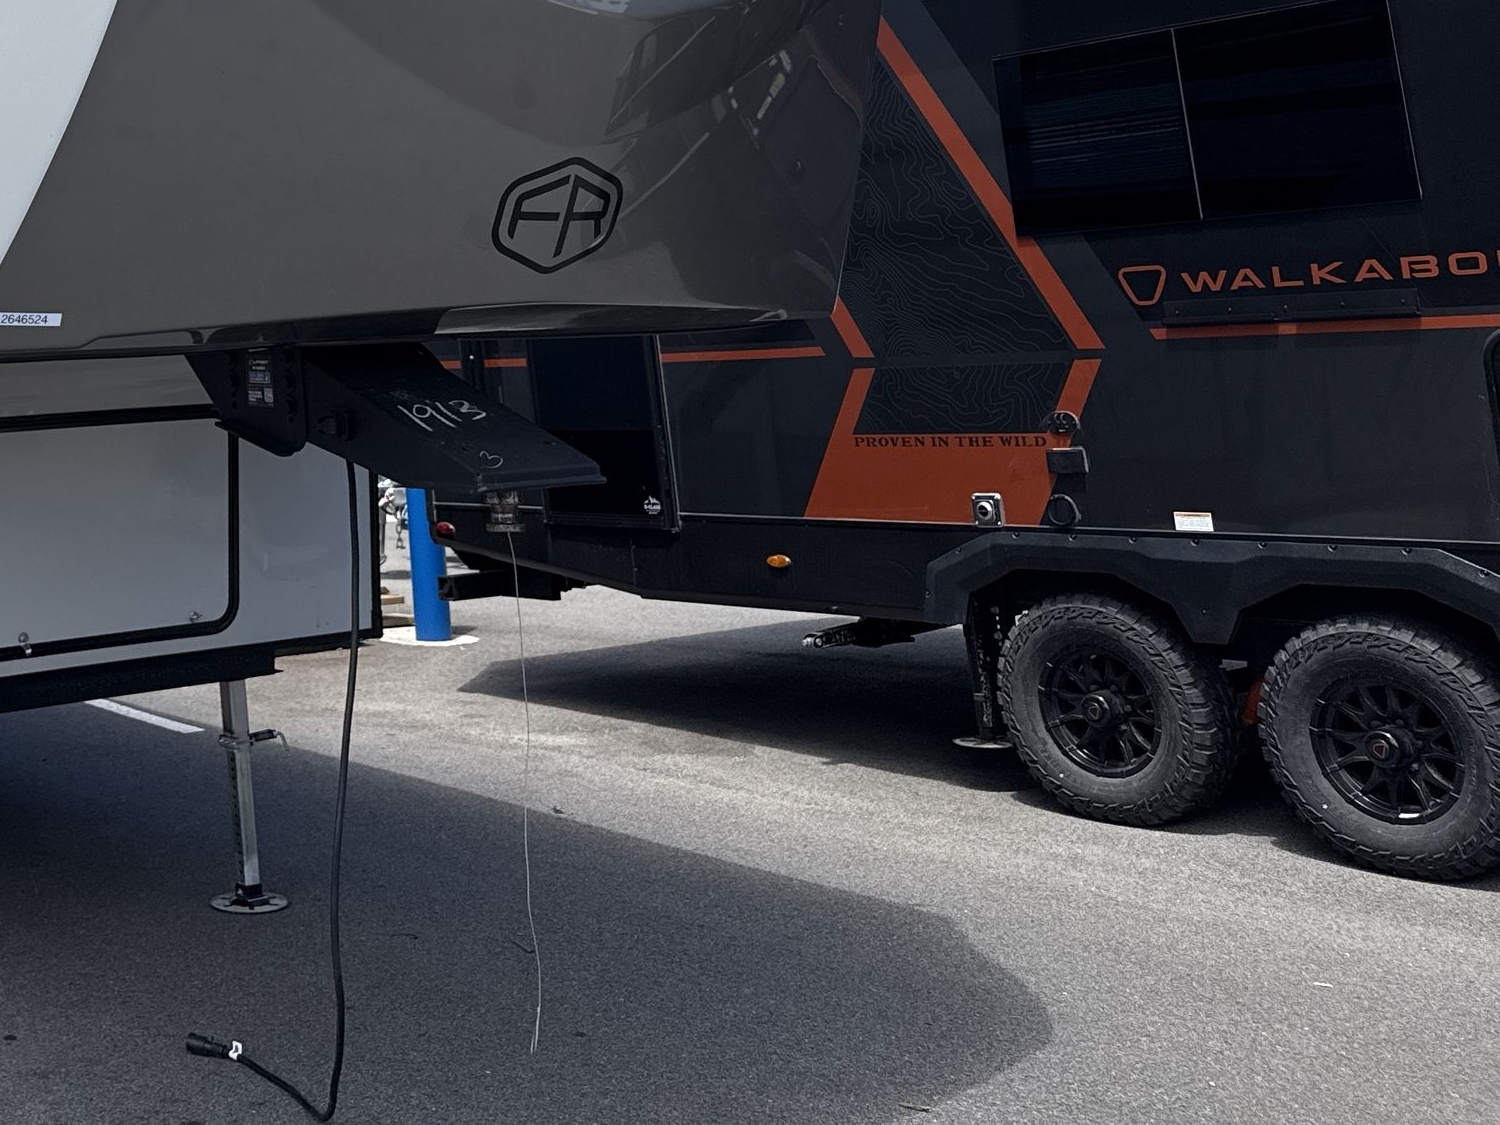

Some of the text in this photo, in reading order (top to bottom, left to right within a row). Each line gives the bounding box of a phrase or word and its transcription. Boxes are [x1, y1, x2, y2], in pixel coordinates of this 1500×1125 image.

[1180, 249, 1500, 293] WALKABO
[1, 314, 48, 325] 2646524
[854, 435, 1047, 448] PROVEN IN THE WILD
